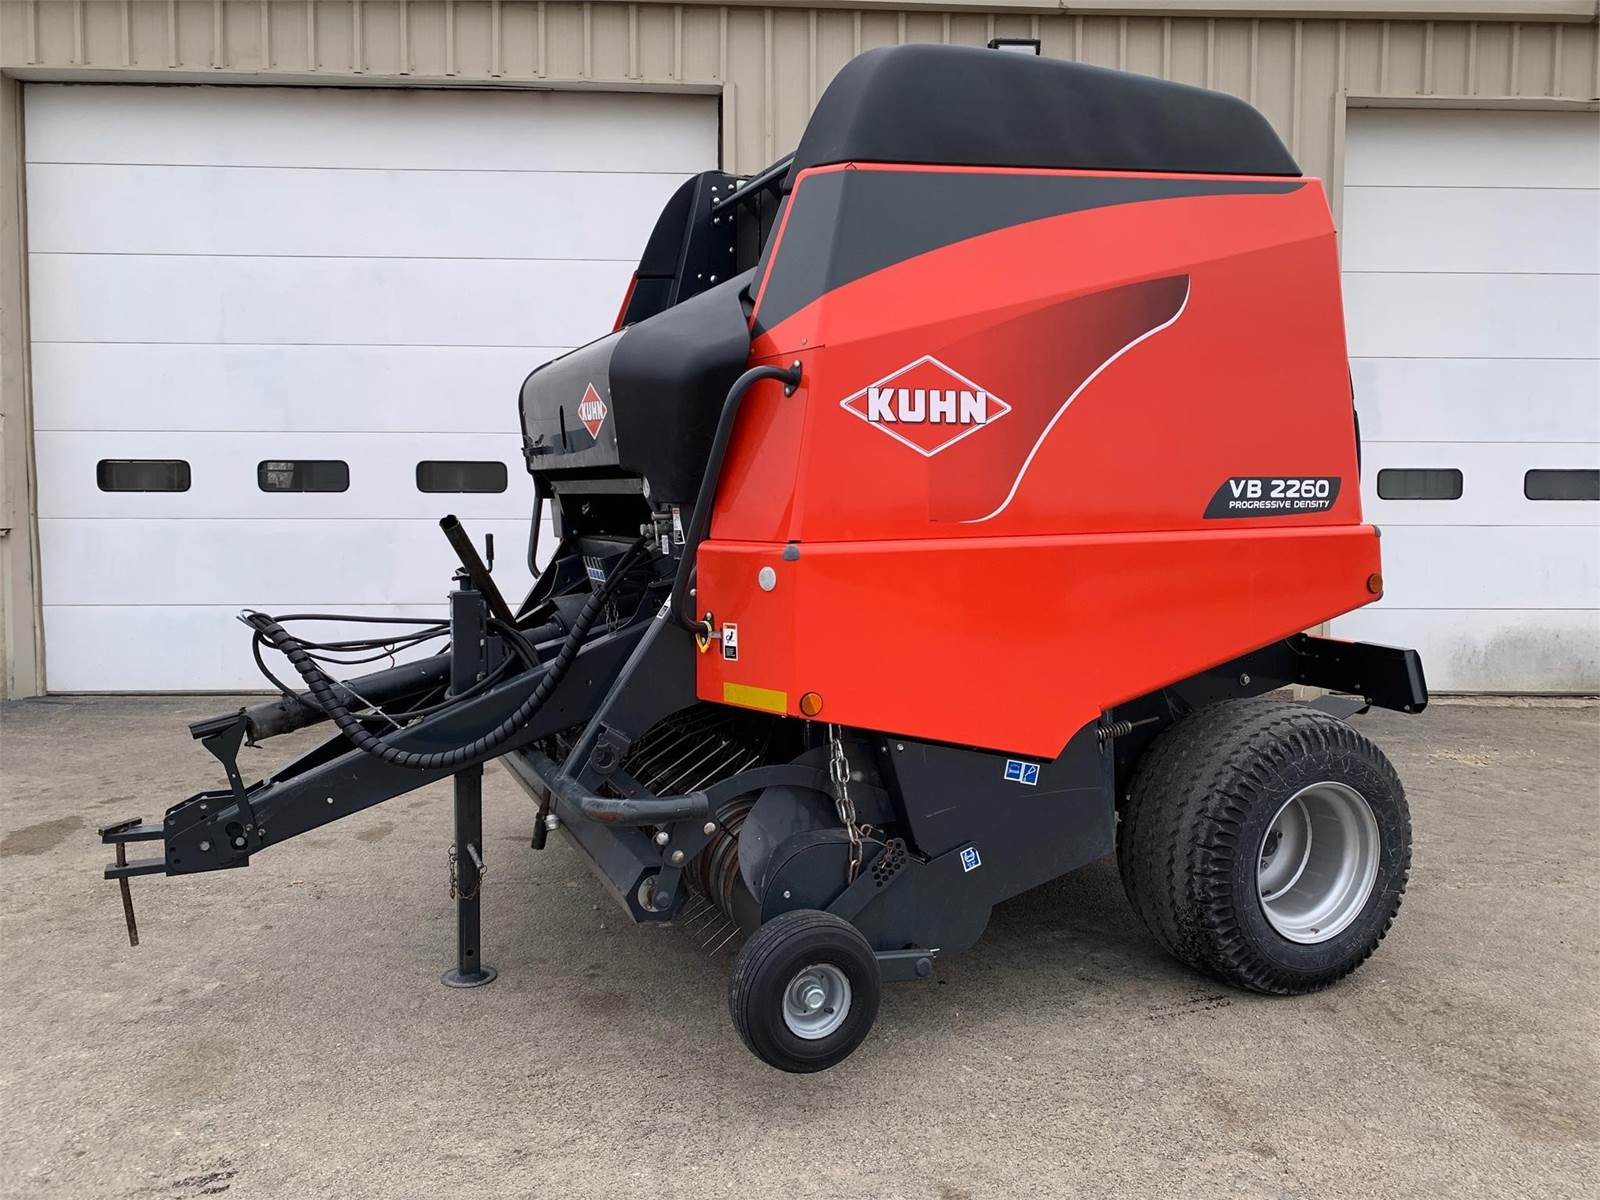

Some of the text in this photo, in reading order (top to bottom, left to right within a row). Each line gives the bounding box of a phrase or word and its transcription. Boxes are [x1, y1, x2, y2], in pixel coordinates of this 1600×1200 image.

[580, 401, 604, 420] KUHN
[867, 387, 987, 424] KUHN
[1229, 479, 1330, 498] VB 2260
[1228, 500, 1291, 509] PROGRESSIVE
